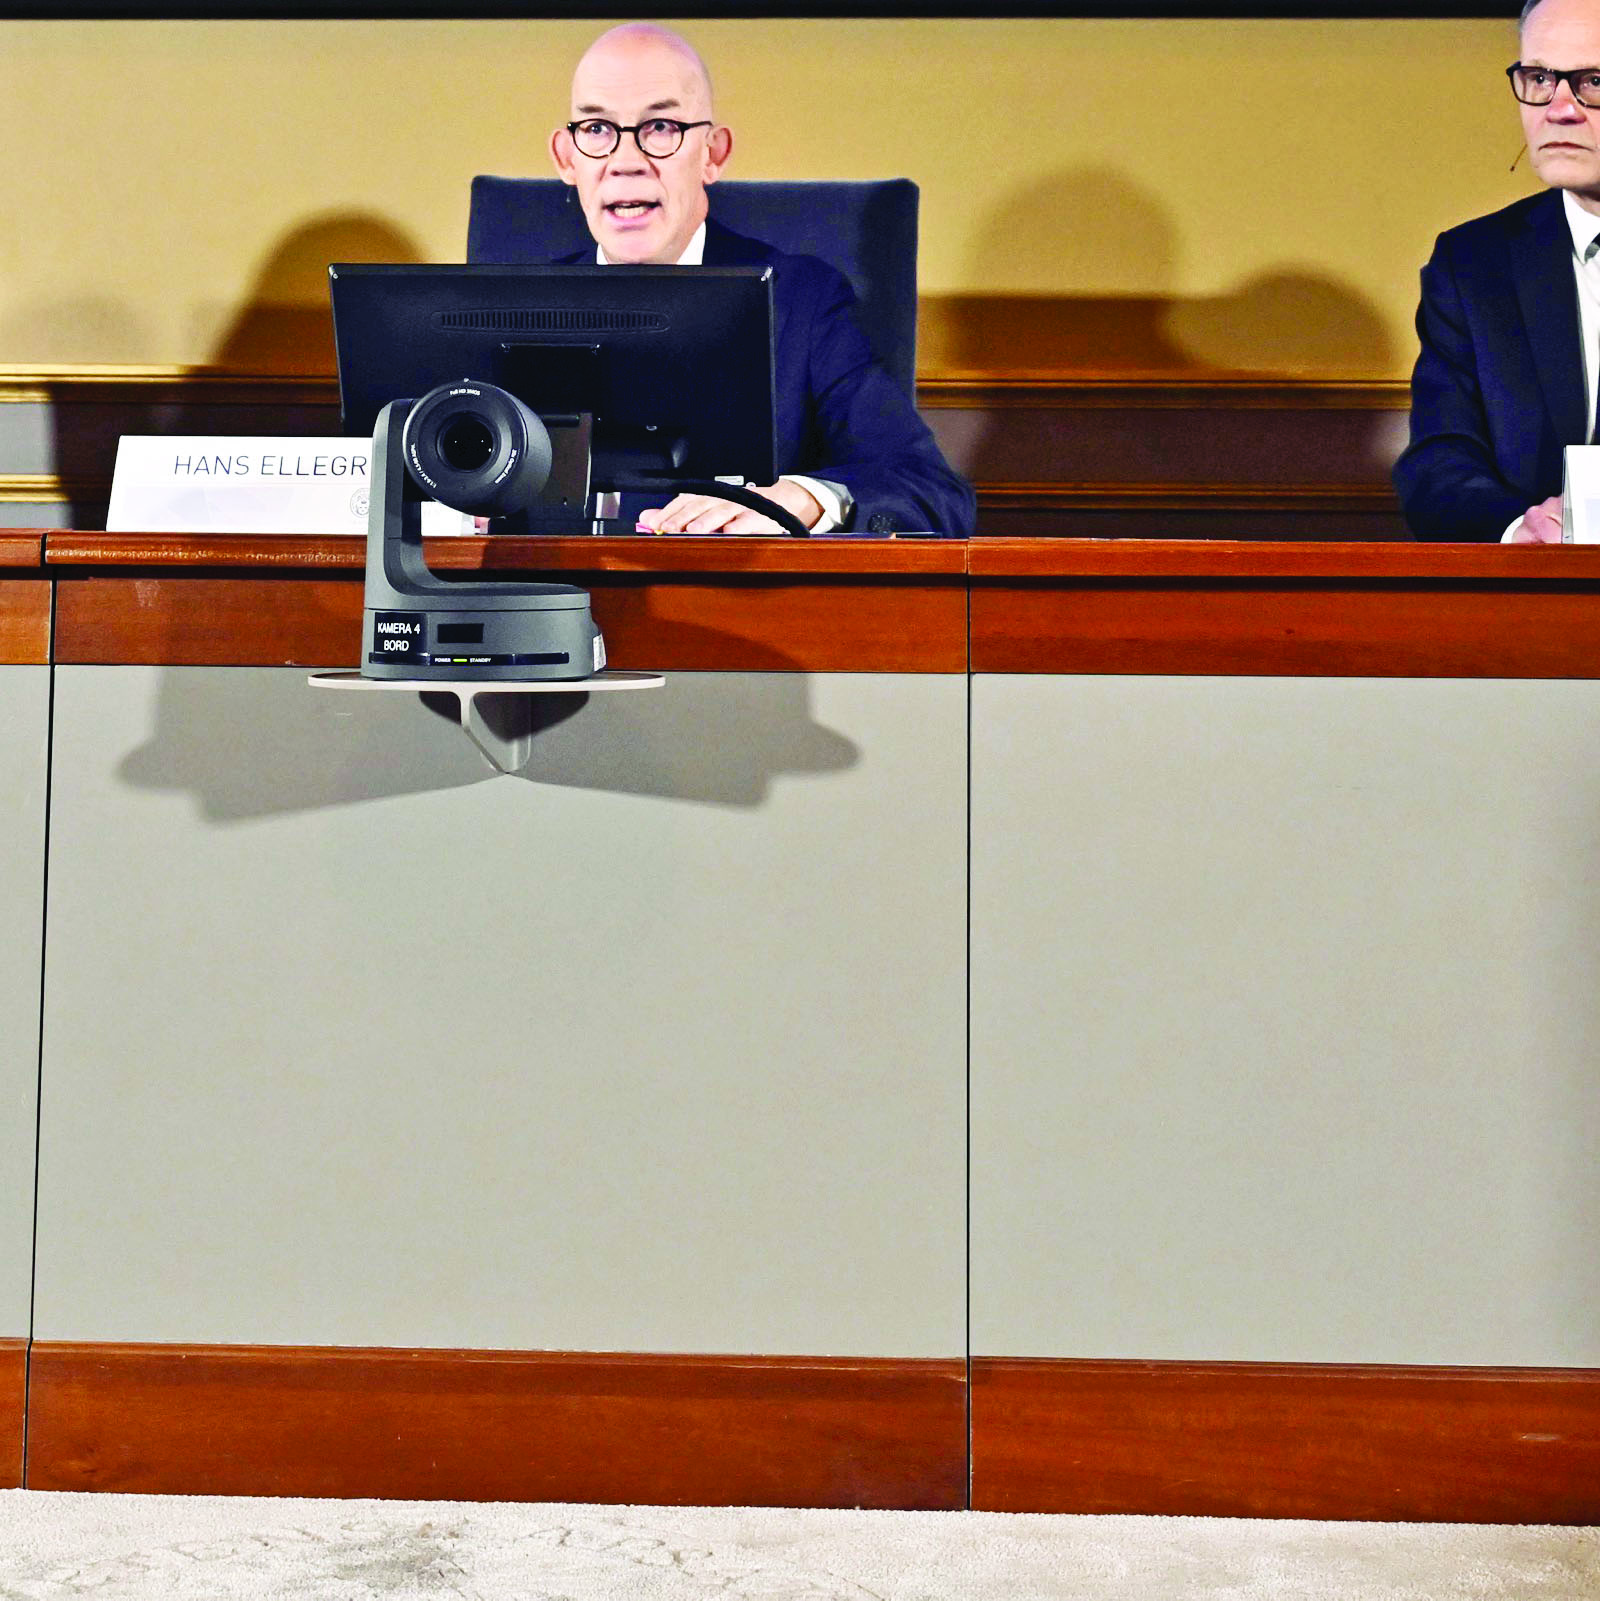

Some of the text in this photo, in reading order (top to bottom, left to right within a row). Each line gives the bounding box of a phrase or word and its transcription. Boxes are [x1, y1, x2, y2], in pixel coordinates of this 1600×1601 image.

[174, 455, 249, 475] HANS
[378, 623, 420, 634] KAMERA 4
[384, 640, 409, 651] BORD
